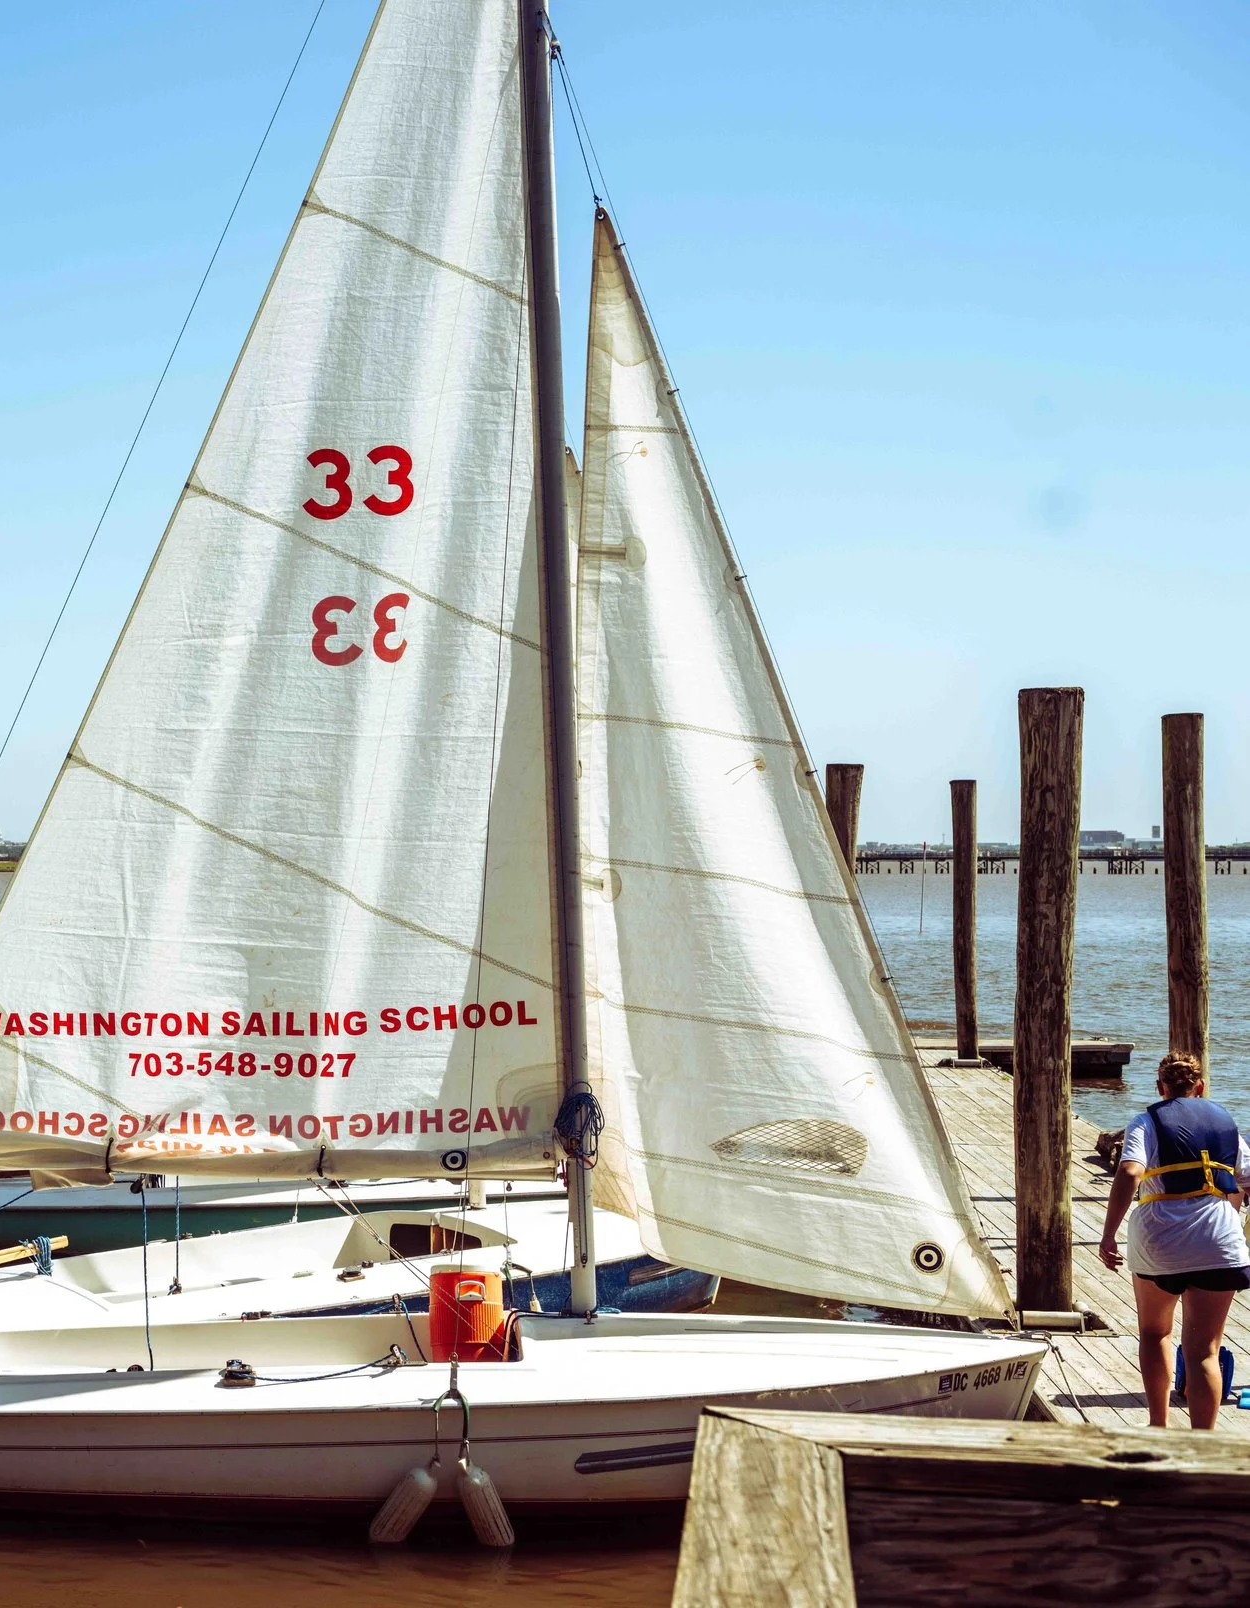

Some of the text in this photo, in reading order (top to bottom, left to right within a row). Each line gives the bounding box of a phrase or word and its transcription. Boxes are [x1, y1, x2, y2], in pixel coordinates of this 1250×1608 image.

[302, 444, 414, 520] 33
[221, 1010, 368, 1037] SAILING
[379, 1000, 538, 1033] SCHOOL
[128, 1051, 357, 1078] 703-548-9027
[952, 1372, 968, 1392] DC
[973, 1365, 1002, 1390] 4668
